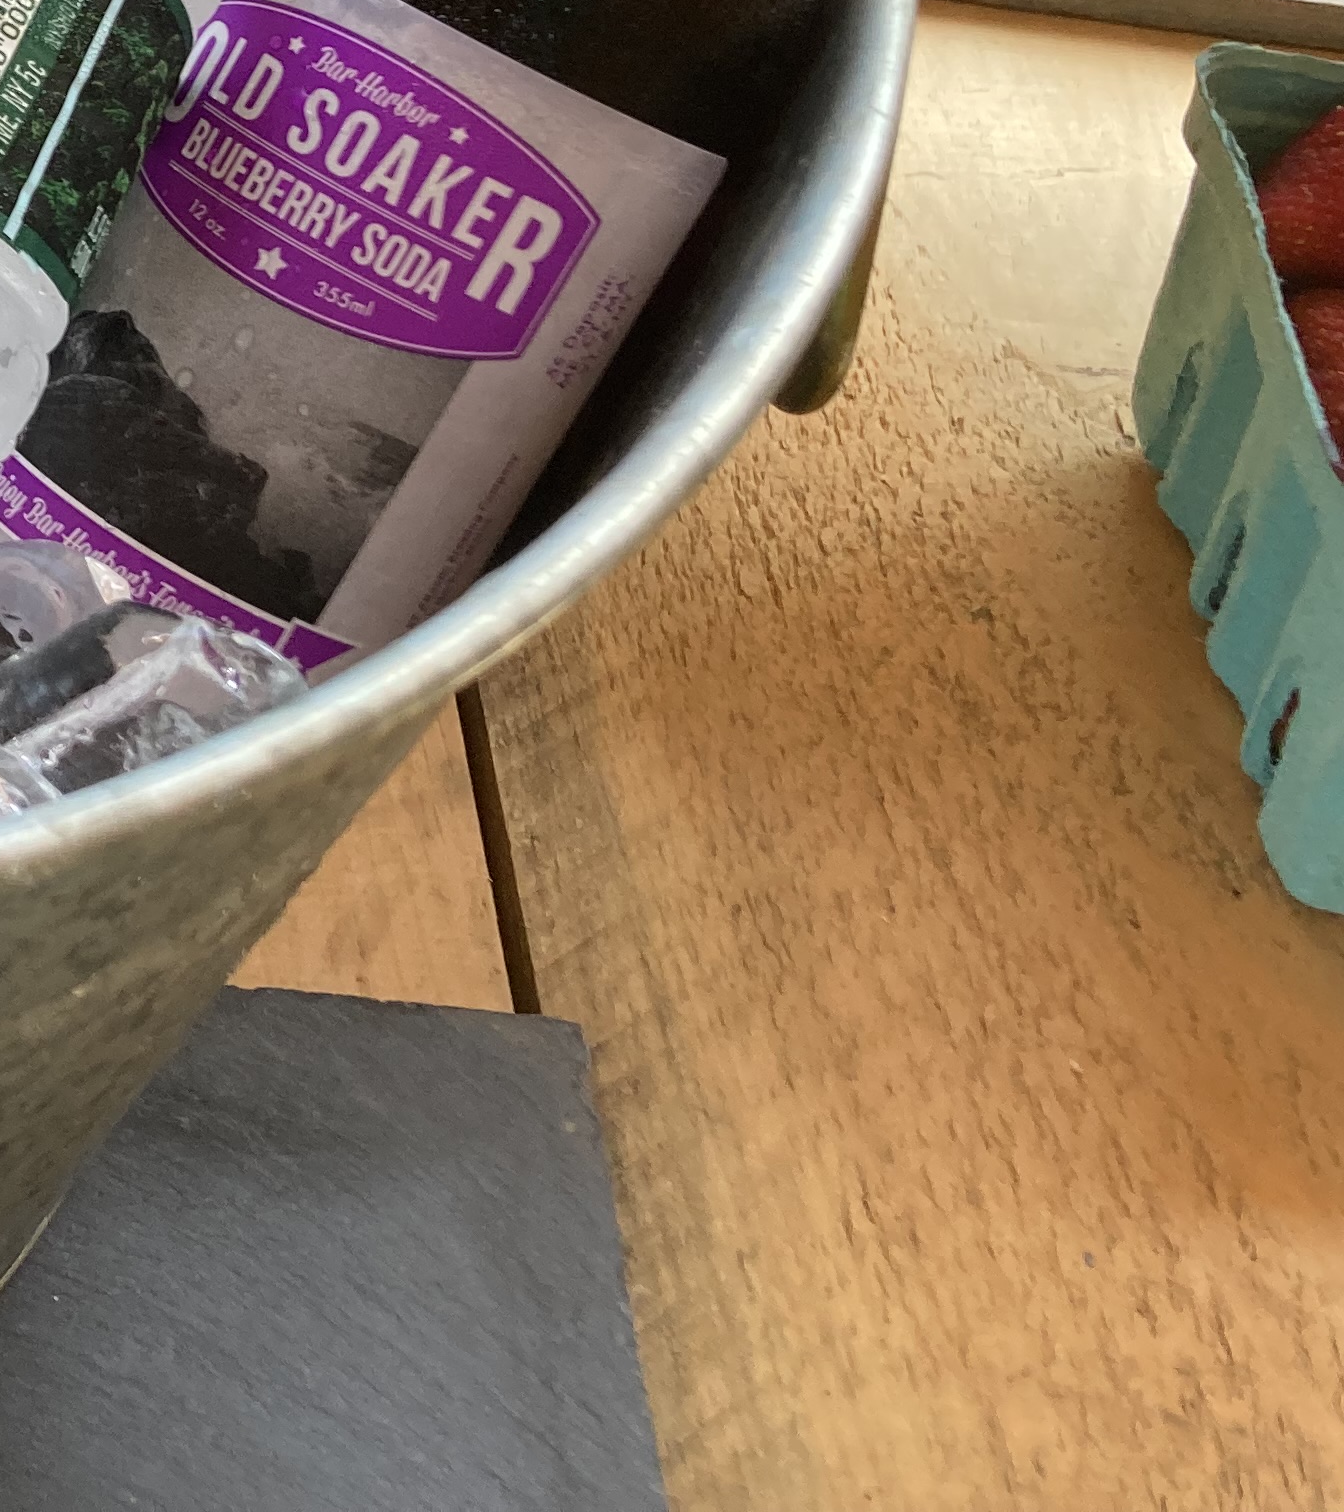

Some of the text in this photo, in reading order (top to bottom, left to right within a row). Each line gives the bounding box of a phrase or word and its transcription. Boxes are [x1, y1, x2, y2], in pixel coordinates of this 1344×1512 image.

[0, 75, 35, 114] NY
[310, 45, 442, 129] Bar Harbor
[164, 20, 286, 123] OLD
[285, 85, 564, 317] SOAKER
[180, 117, 362, 251] BLUEBERRY
[349, 221, 453, 304] SODA
[187, 198, 228, 242] 12 oz.
[312, 280, 377, 318] 355ml
[21, 495, 66, 541] Bar
